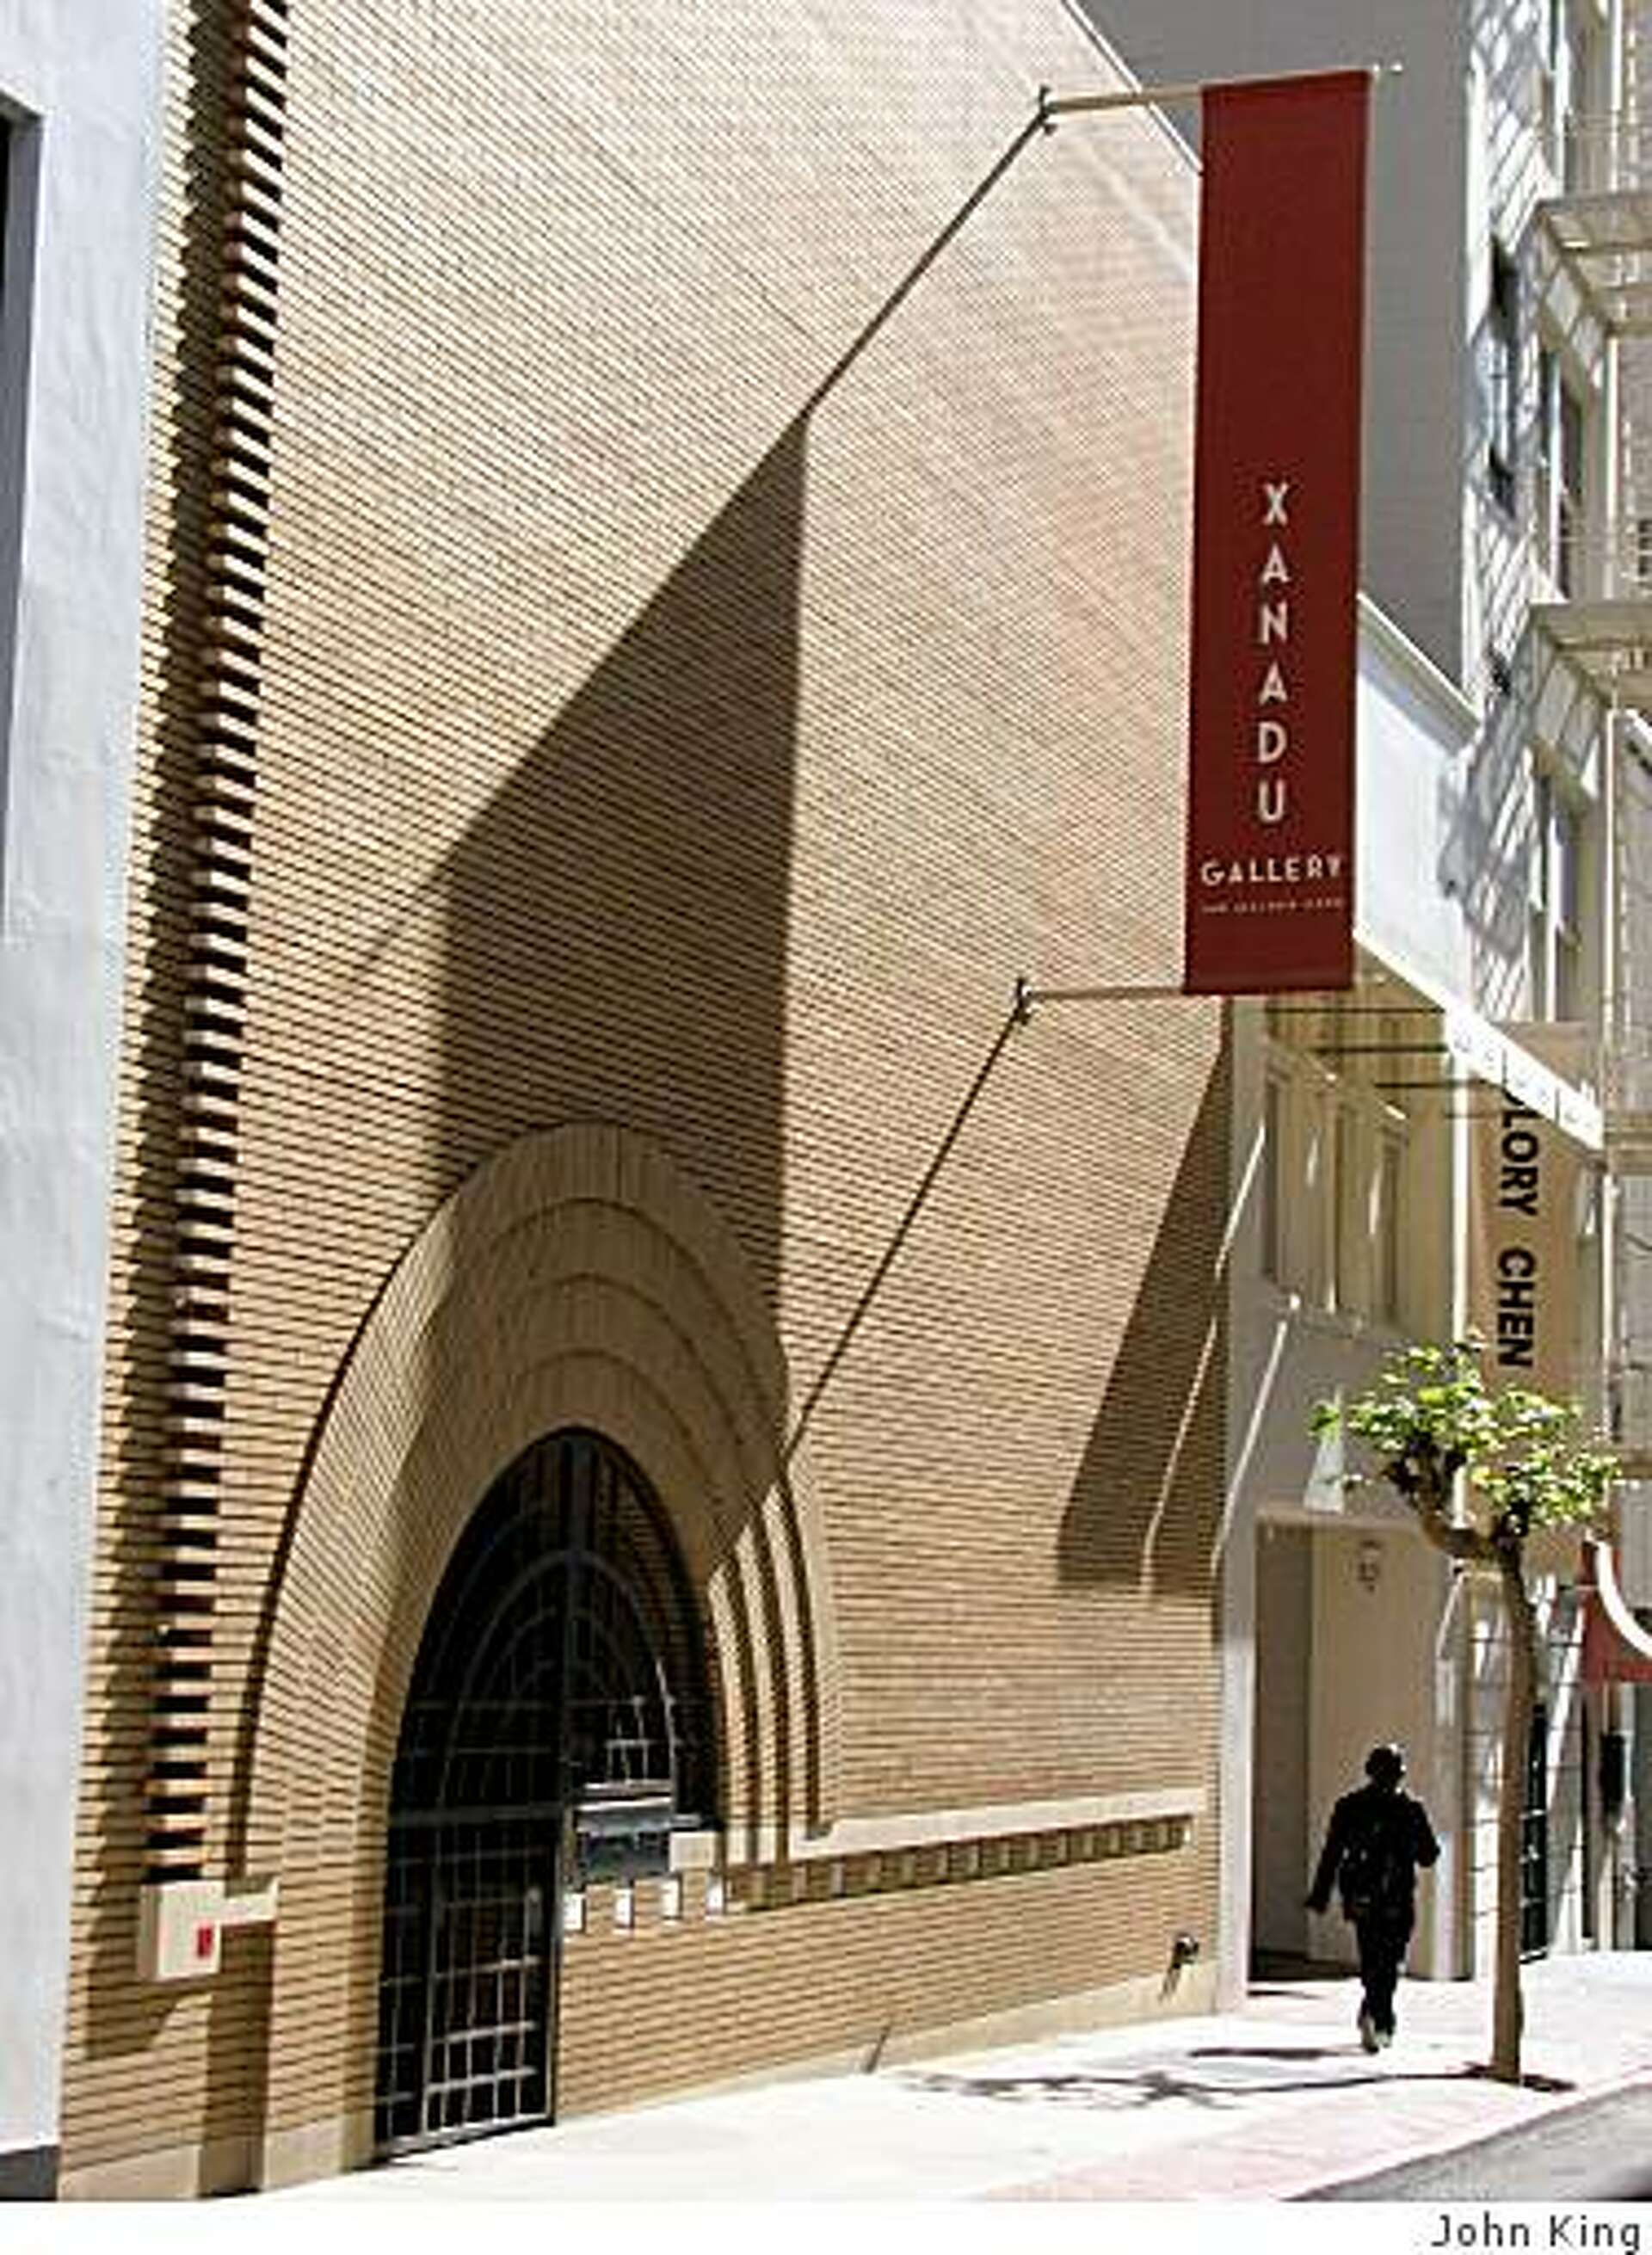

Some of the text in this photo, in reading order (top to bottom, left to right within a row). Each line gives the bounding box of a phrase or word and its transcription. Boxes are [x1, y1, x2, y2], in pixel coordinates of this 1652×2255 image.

[1258, 482, 1291, 822] XANADU
[1201, 854, 1341, 886] GALLERY
[1497, 1247, 1536, 1367] CHEN
